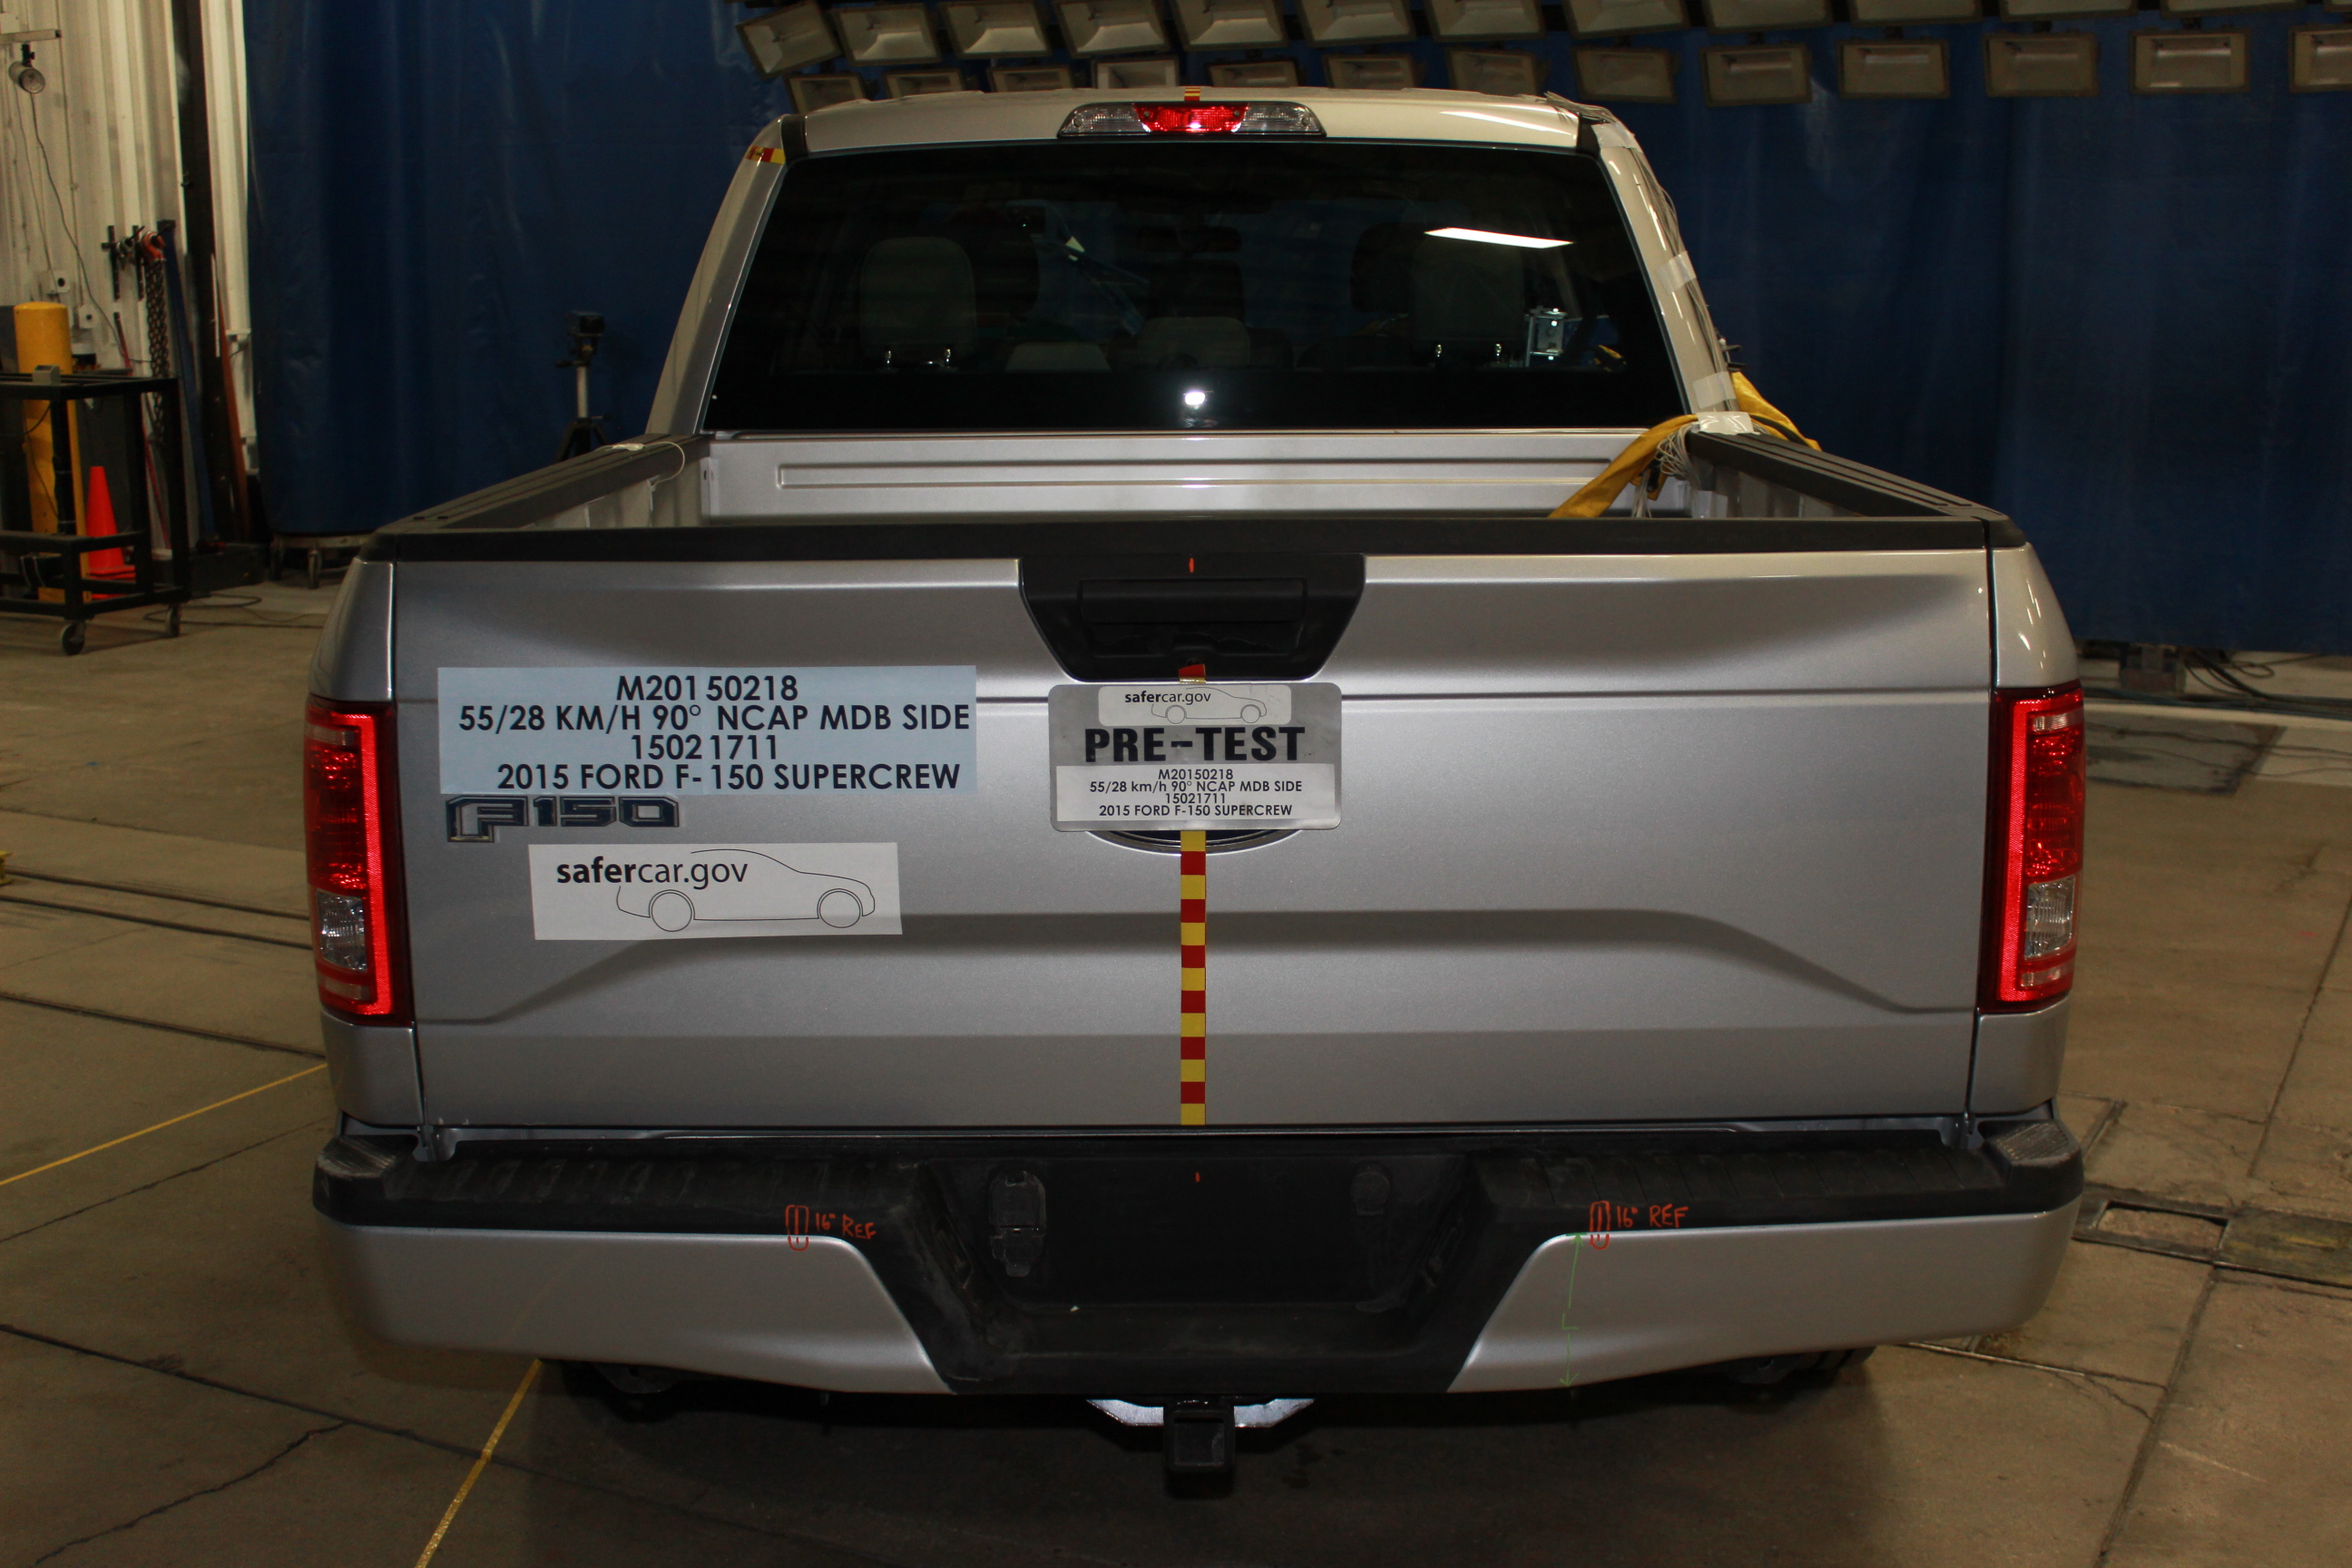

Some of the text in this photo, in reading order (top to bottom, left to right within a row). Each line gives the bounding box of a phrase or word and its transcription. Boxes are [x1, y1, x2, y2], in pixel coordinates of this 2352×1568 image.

[616, 674, 799, 701] M20150218
[1124, 691, 1211, 705] safercar.gov
[459, 703, 970, 735] 55/28 KM/H 90° NCAP MDB SIDE
[632, 733, 777, 760] 15021711
[1085, 725, 1305, 763] PRE-TEST
[497, 762, 961, 790] 2015 FORD F-150 SUPERCREW
[1090, 780, 1302, 794] 55/28 km/h 90° NCAP MDB SIDE
[1158, 769, 1234, 780] M20150218
[1099, 804, 1293, 817] 2015 FORD F-150 SUPERCREW
[1165, 792, 1226, 804] 15021711
[556, 856, 749, 890] safercar.gov
[842, 1213, 877, 1240] REF
[1649, 1203, 1690, 1229] REF
